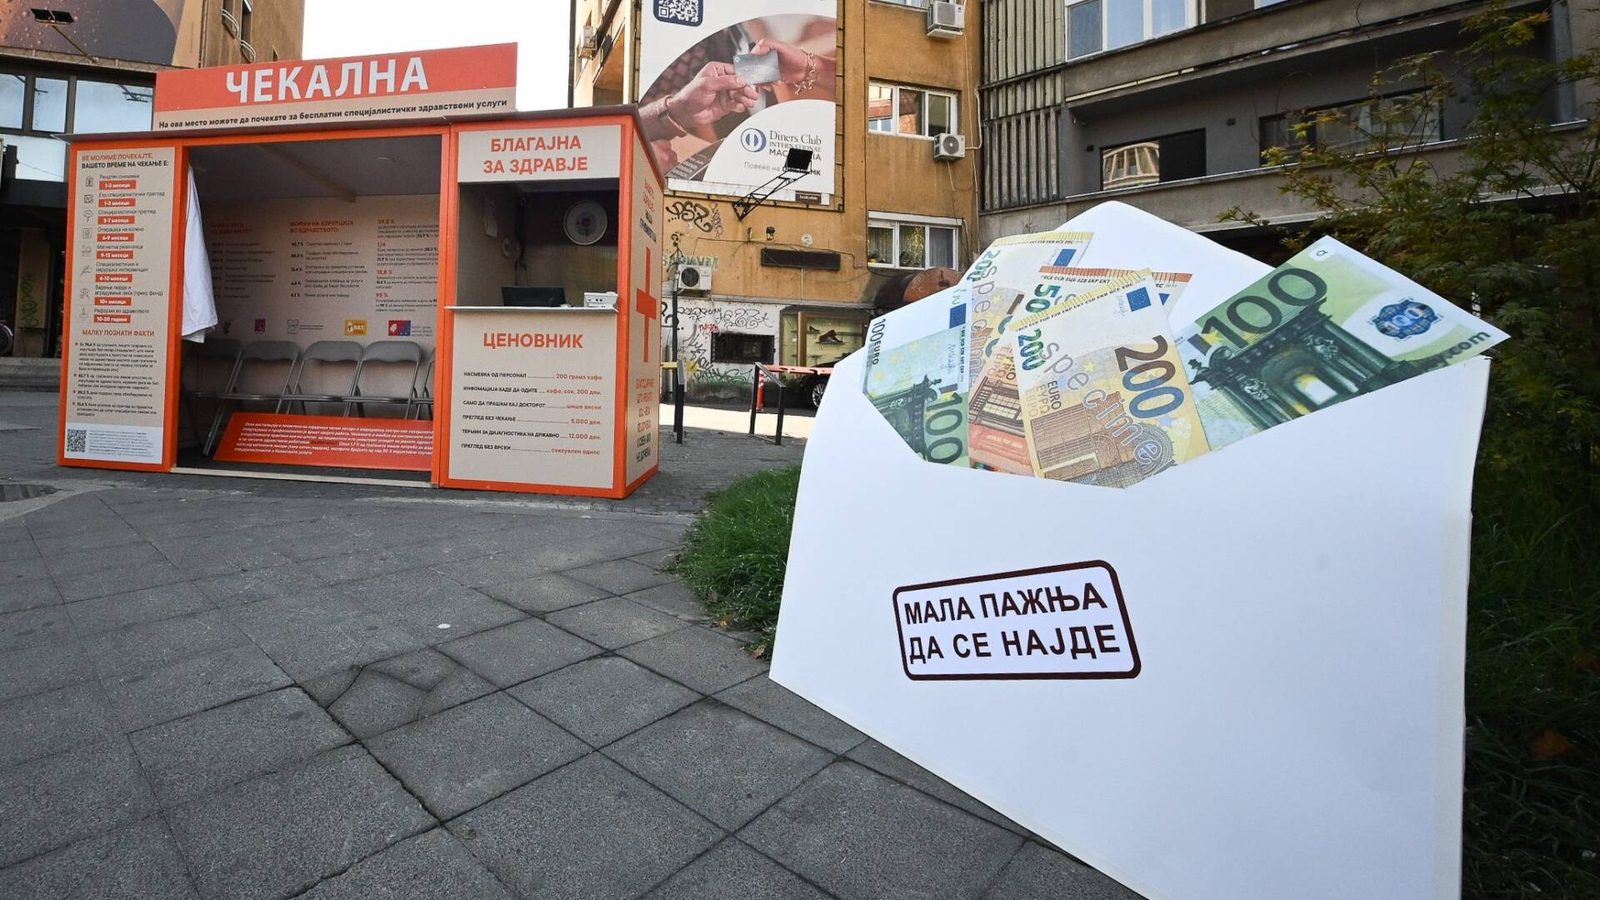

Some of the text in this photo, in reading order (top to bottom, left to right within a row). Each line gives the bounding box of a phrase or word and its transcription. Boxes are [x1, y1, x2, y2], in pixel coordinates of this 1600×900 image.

[226, 57, 429, 104] ЧЕКАЛНА
[251, 115, 287, 123] почекате
[299, 110, 342, 119] бесплатни
[344, 105, 417, 116] специјалистички
[418, 102, 474, 112] здравствени
[476, 99, 508, 109] услуги
[490, 135, 581, 153] БЛАГАЈНА
[769, 130, 822, 145] Diners Club
[769, 149, 822, 161] MACIA
[483, 156, 588, 175] ЗА ЗДРАВЈЕ
[1025, 283, 1062, 314] 50
[1201, 267, 1328, 352] 100
[483, 332, 583, 349] ЦЕНОВНИК
[870, 317, 886, 366] 100 EURO
[1017, 328, 1046, 371] 200
[1047, 380, 1062, 410] EURO
[1114, 335, 1185, 419] 200
[925, 390, 963, 464] 100
[904, 582, 1108, 625] МАЛА ПАЖЊА
[909, 624, 1121, 665] ДА СЕ НАЈДЕ
